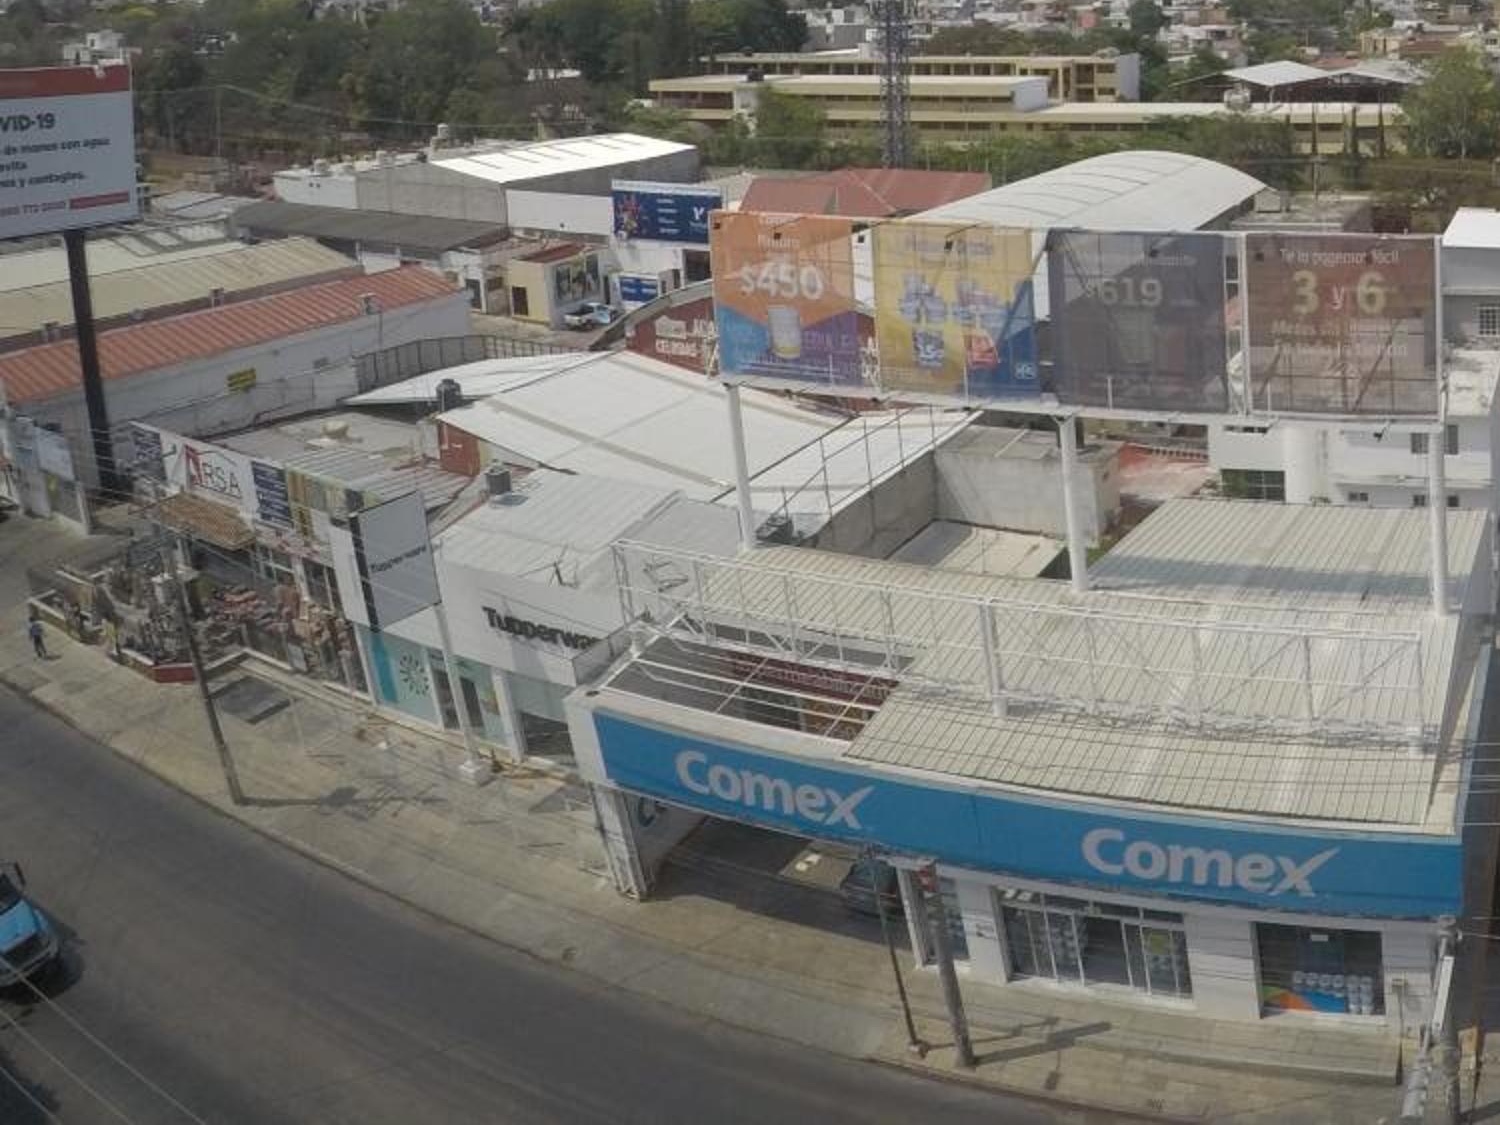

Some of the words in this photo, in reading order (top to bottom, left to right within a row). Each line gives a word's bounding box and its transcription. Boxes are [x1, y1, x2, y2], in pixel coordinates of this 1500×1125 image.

[1292, 269, 1319, 315] 3
[1357, 271, 1387, 315] 6
[674, 748, 876, 830] Comex
[1081, 827, 1341, 898] Comex
